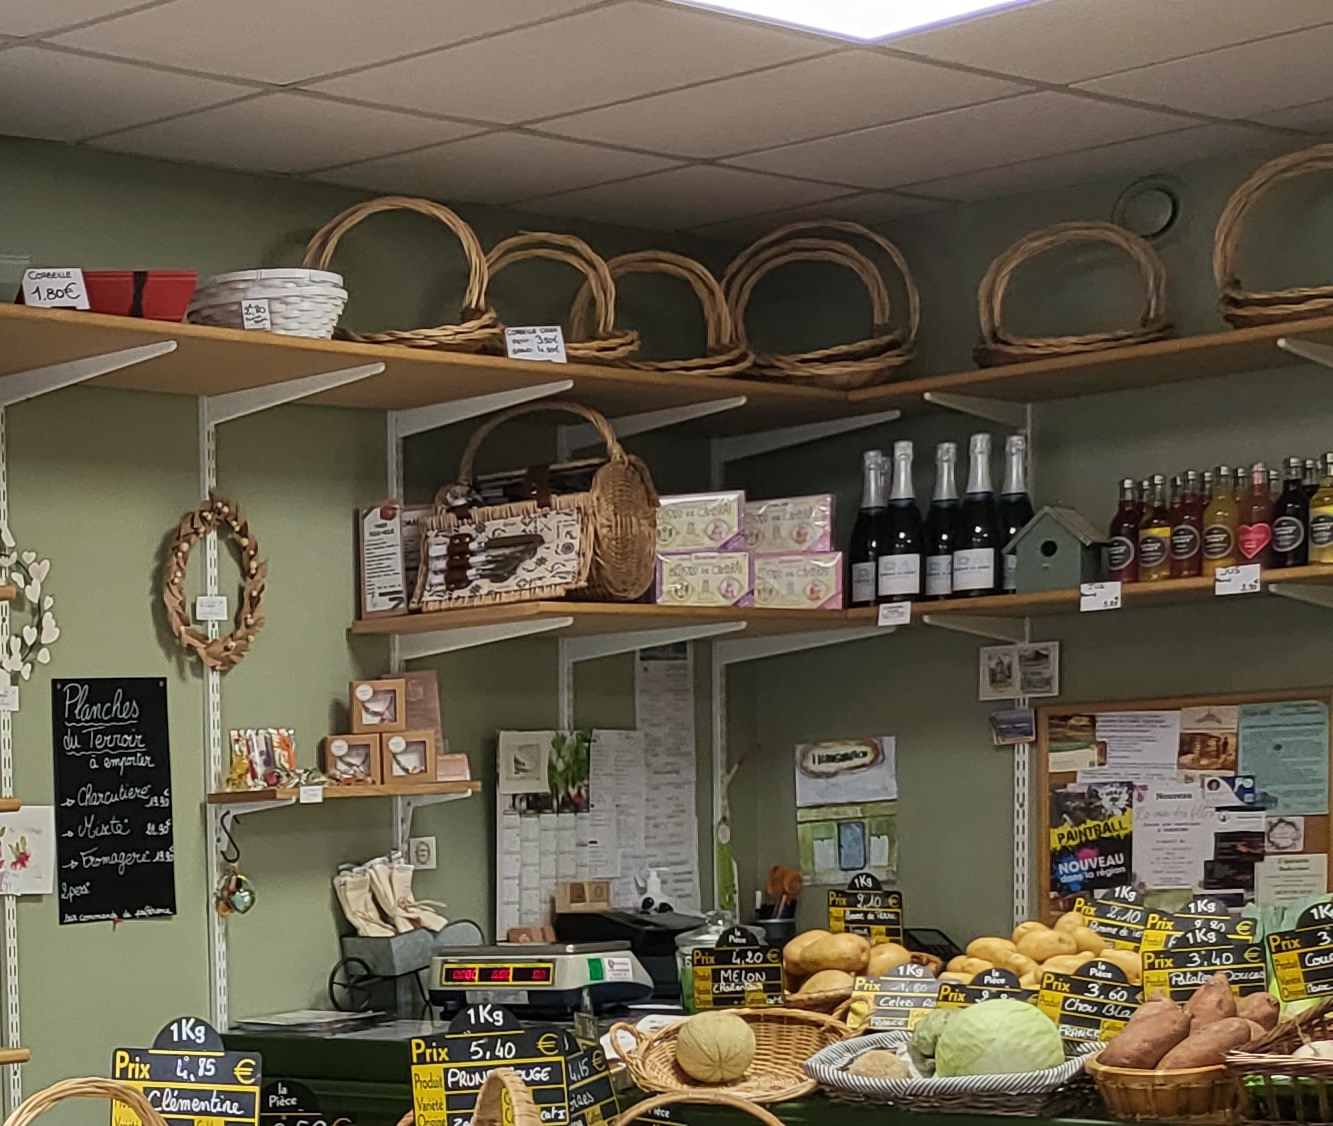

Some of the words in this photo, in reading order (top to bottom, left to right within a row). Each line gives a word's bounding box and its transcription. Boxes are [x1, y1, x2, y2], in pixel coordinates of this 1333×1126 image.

[63, 683, 139, 720] Planches
[63, 728, 80, 750] du
[82, 727, 146, 749] Terroir
[104, 753, 155, 775] emporter
[1057, 820, 1128, 844] PAINTBALL
[1058, 853, 1124, 875] NOUVEAU
[1097, 866, 1126, 879] région
[829, 891, 847, 906] Prix
[1074, 898, 1097, 916] Prix
[1147, 914, 1174, 930] Prix
[1269, 935, 1301, 952] Prix
[693, 951, 715, 965] Prix
[1144, 953, 1174, 968] Prix
[720, 970, 766, 983] MELON
[855, 978, 881, 992] Prix
[1042, 974, 1071, 992] Prix
[940, 987, 966, 1002] Prix
[467, 1004, 504, 1026] 1Kg
[170, 1023, 206, 1044] 1Kg
[411, 1038, 450, 1063] Prix
[536, 1033, 559, 1056] €
[115, 1051, 151, 1080] Prix
[234, 1058, 256, 1085] €
[278, 1083, 288, 1095] la
[148, 1088, 245, 1115] Clémentine
[269, 1095, 297, 1107] Pièce
